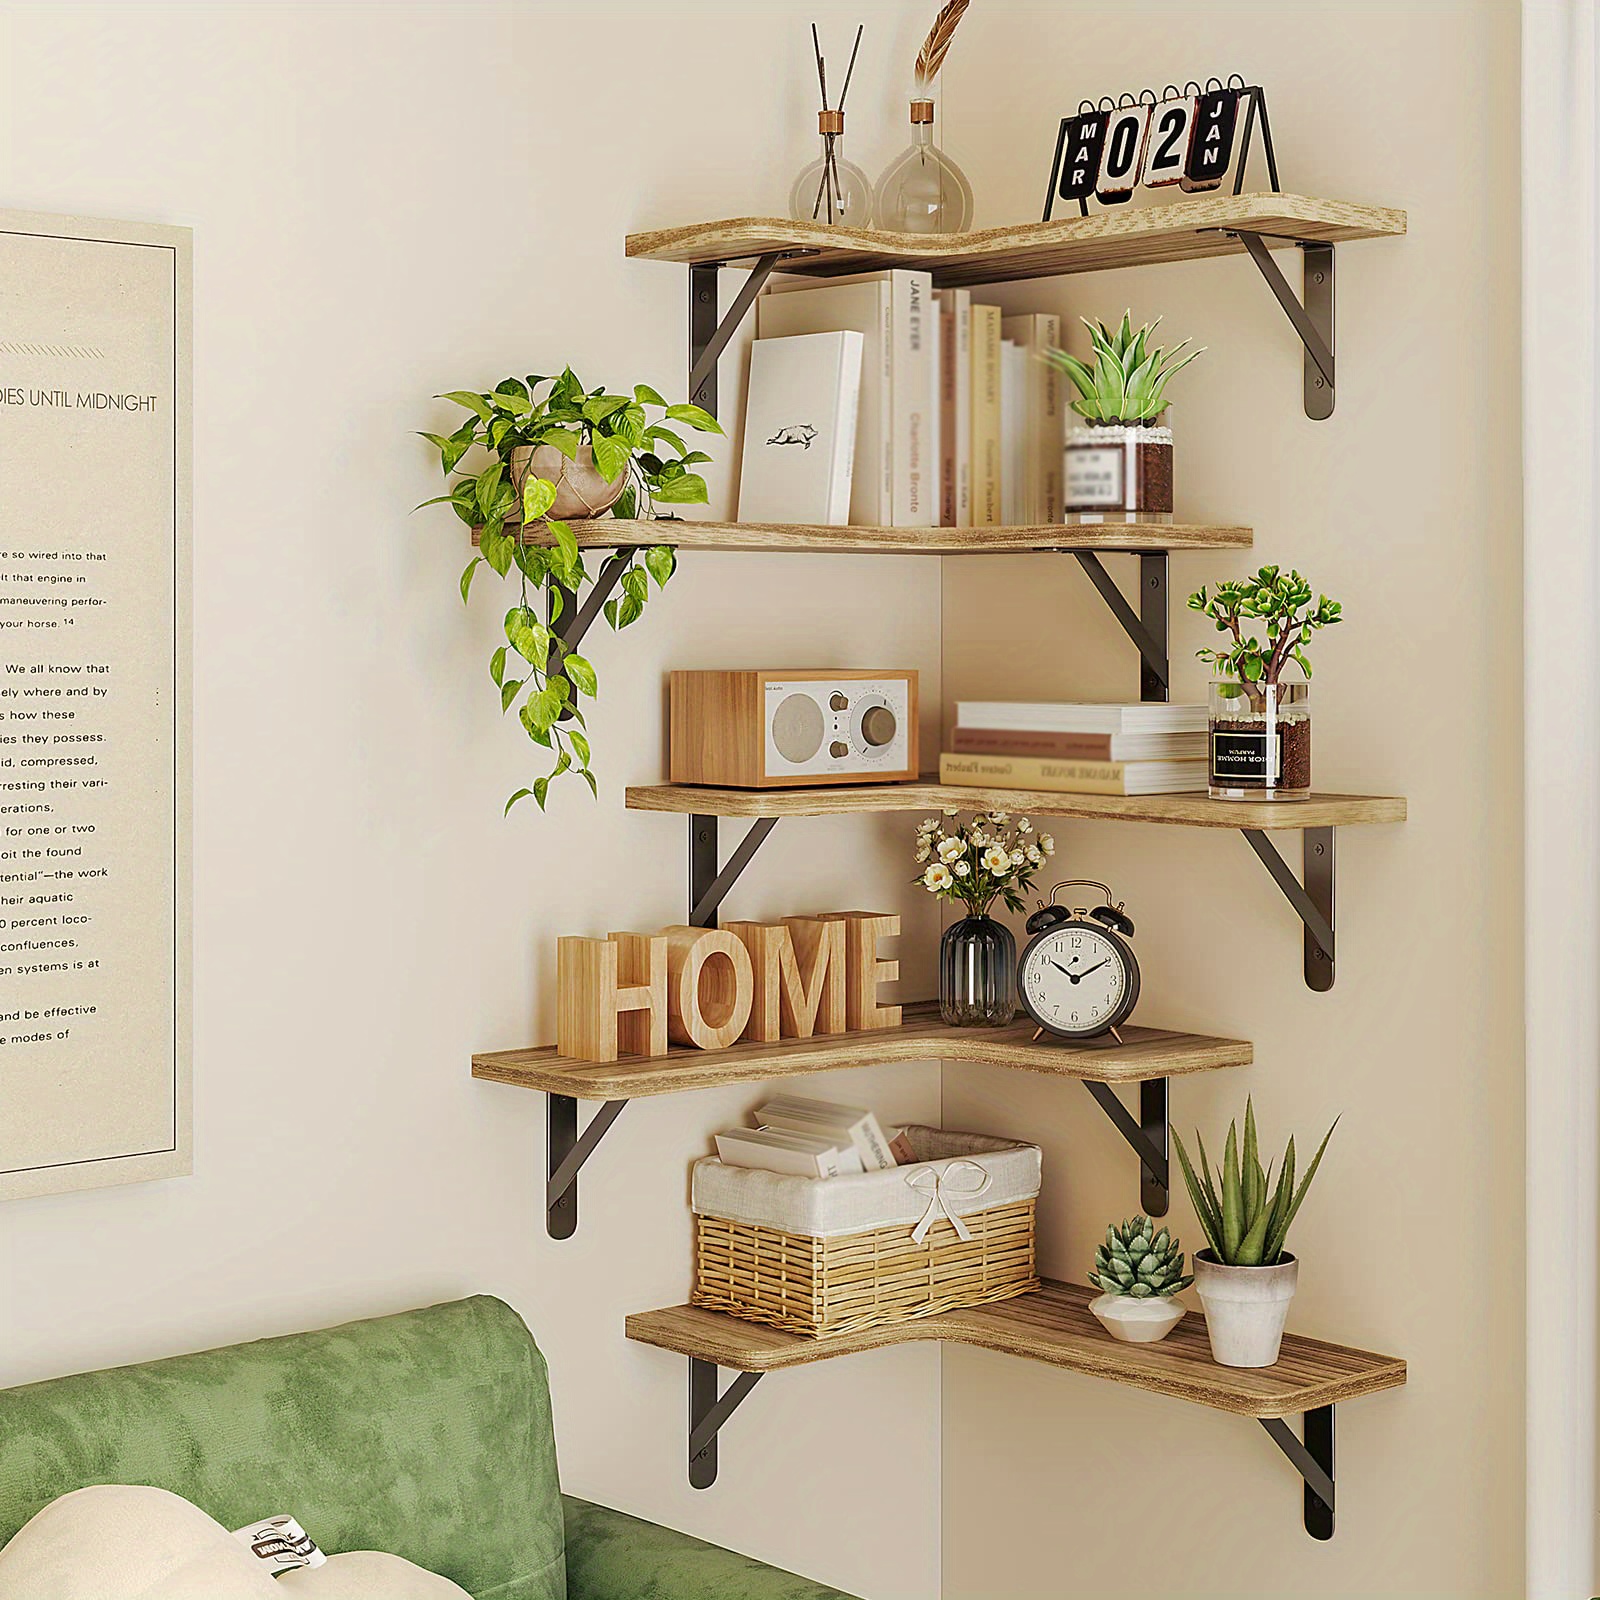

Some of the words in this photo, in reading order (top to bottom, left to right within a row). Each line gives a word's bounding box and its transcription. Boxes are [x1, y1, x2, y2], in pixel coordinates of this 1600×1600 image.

[1202, 100, 1223, 166] JAN
[909, 279, 920, 313] JANE
[29, 389, 73, 408] UNTIL
[76, 392, 158, 412] MIDNIGHT
[909, 472, 920, 513] Bronte
[1046, 496, 1055, 523] Bronte
[11, 551, 25, 559] so
[28, 550, 58, 561] wired
[61, 550, 83, 561] into
[85, 551, 107, 561] that
[12, 573, 34, 582] that
[37, 574, 73, 585] engine
[76, 574, 86, 583] in
[0, 597, 68, 608] maneuvering
[71, 597, 107, 607] perfor-
[0, 620, 24, 630] your
[27, 619, 60, 628] horse.
[63, 617, 74, 625] 14
[5, 664, 26, 674] We
[29, 664, 44, 674] all
[48, 664, 82, 674] know
[86, 664, 110, 674] that
[23, 687, 62, 697] where
[65, 686, 89, 697] and
[92, 686, 108, 698] by
[9, 710, 38, 721] how
[42, 709, 76, 720] these
[21, 733, 49, 745] they
[53, 734, 107, 745] possess.
[20, 755, 98, 768] compressed,
[50, 778, 78, 789] their
[81, 777, 109, 788] vari-
[0, 803, 54, 815] erations,
[5, 826, 23, 837] for
[27, 826, 50, 836] one
[54, 826, 68, 835] or
[71, 823, 96, 834] two
[22, 847, 42, 859] the
[46, 846, 82, 857] found
[77, 867, 109, 878] work
[28, 891, 74, 905] aquatic
[10, 917, 58, 930] percent
[62, 914, 93, 925] loco-
[0, 939, 79, 952] confluences,
[1055, 941, 1064, 953] 11
[1071, 937, 1082, 949] 12
[1092, 942, 1098, 954] 1
[1041, 954, 1051, 966] 10
[17, 962, 69, 976] systems
[72, 959, 84, 970] is
[87, 959, 100, 969] at
[1033, 972, 1041, 984] 9
[1109, 975, 1117, 987] 3
[558, 911, 902, 1062] HOME
[1038, 991, 1046, 1003] 8
[1104, 994, 1111, 1005] 4
[0, 1010, 20, 1023] and
[24, 1009, 40, 1020] be
[43, 1004, 97, 1018] effective
[1053, 1004, 1060, 1016] 7
[1071, 1010, 1079, 1022] 6
[1091, 1005, 1099, 1017] 5
[11, 1032, 53, 1044] modes
[56, 1028, 70, 1040] of
